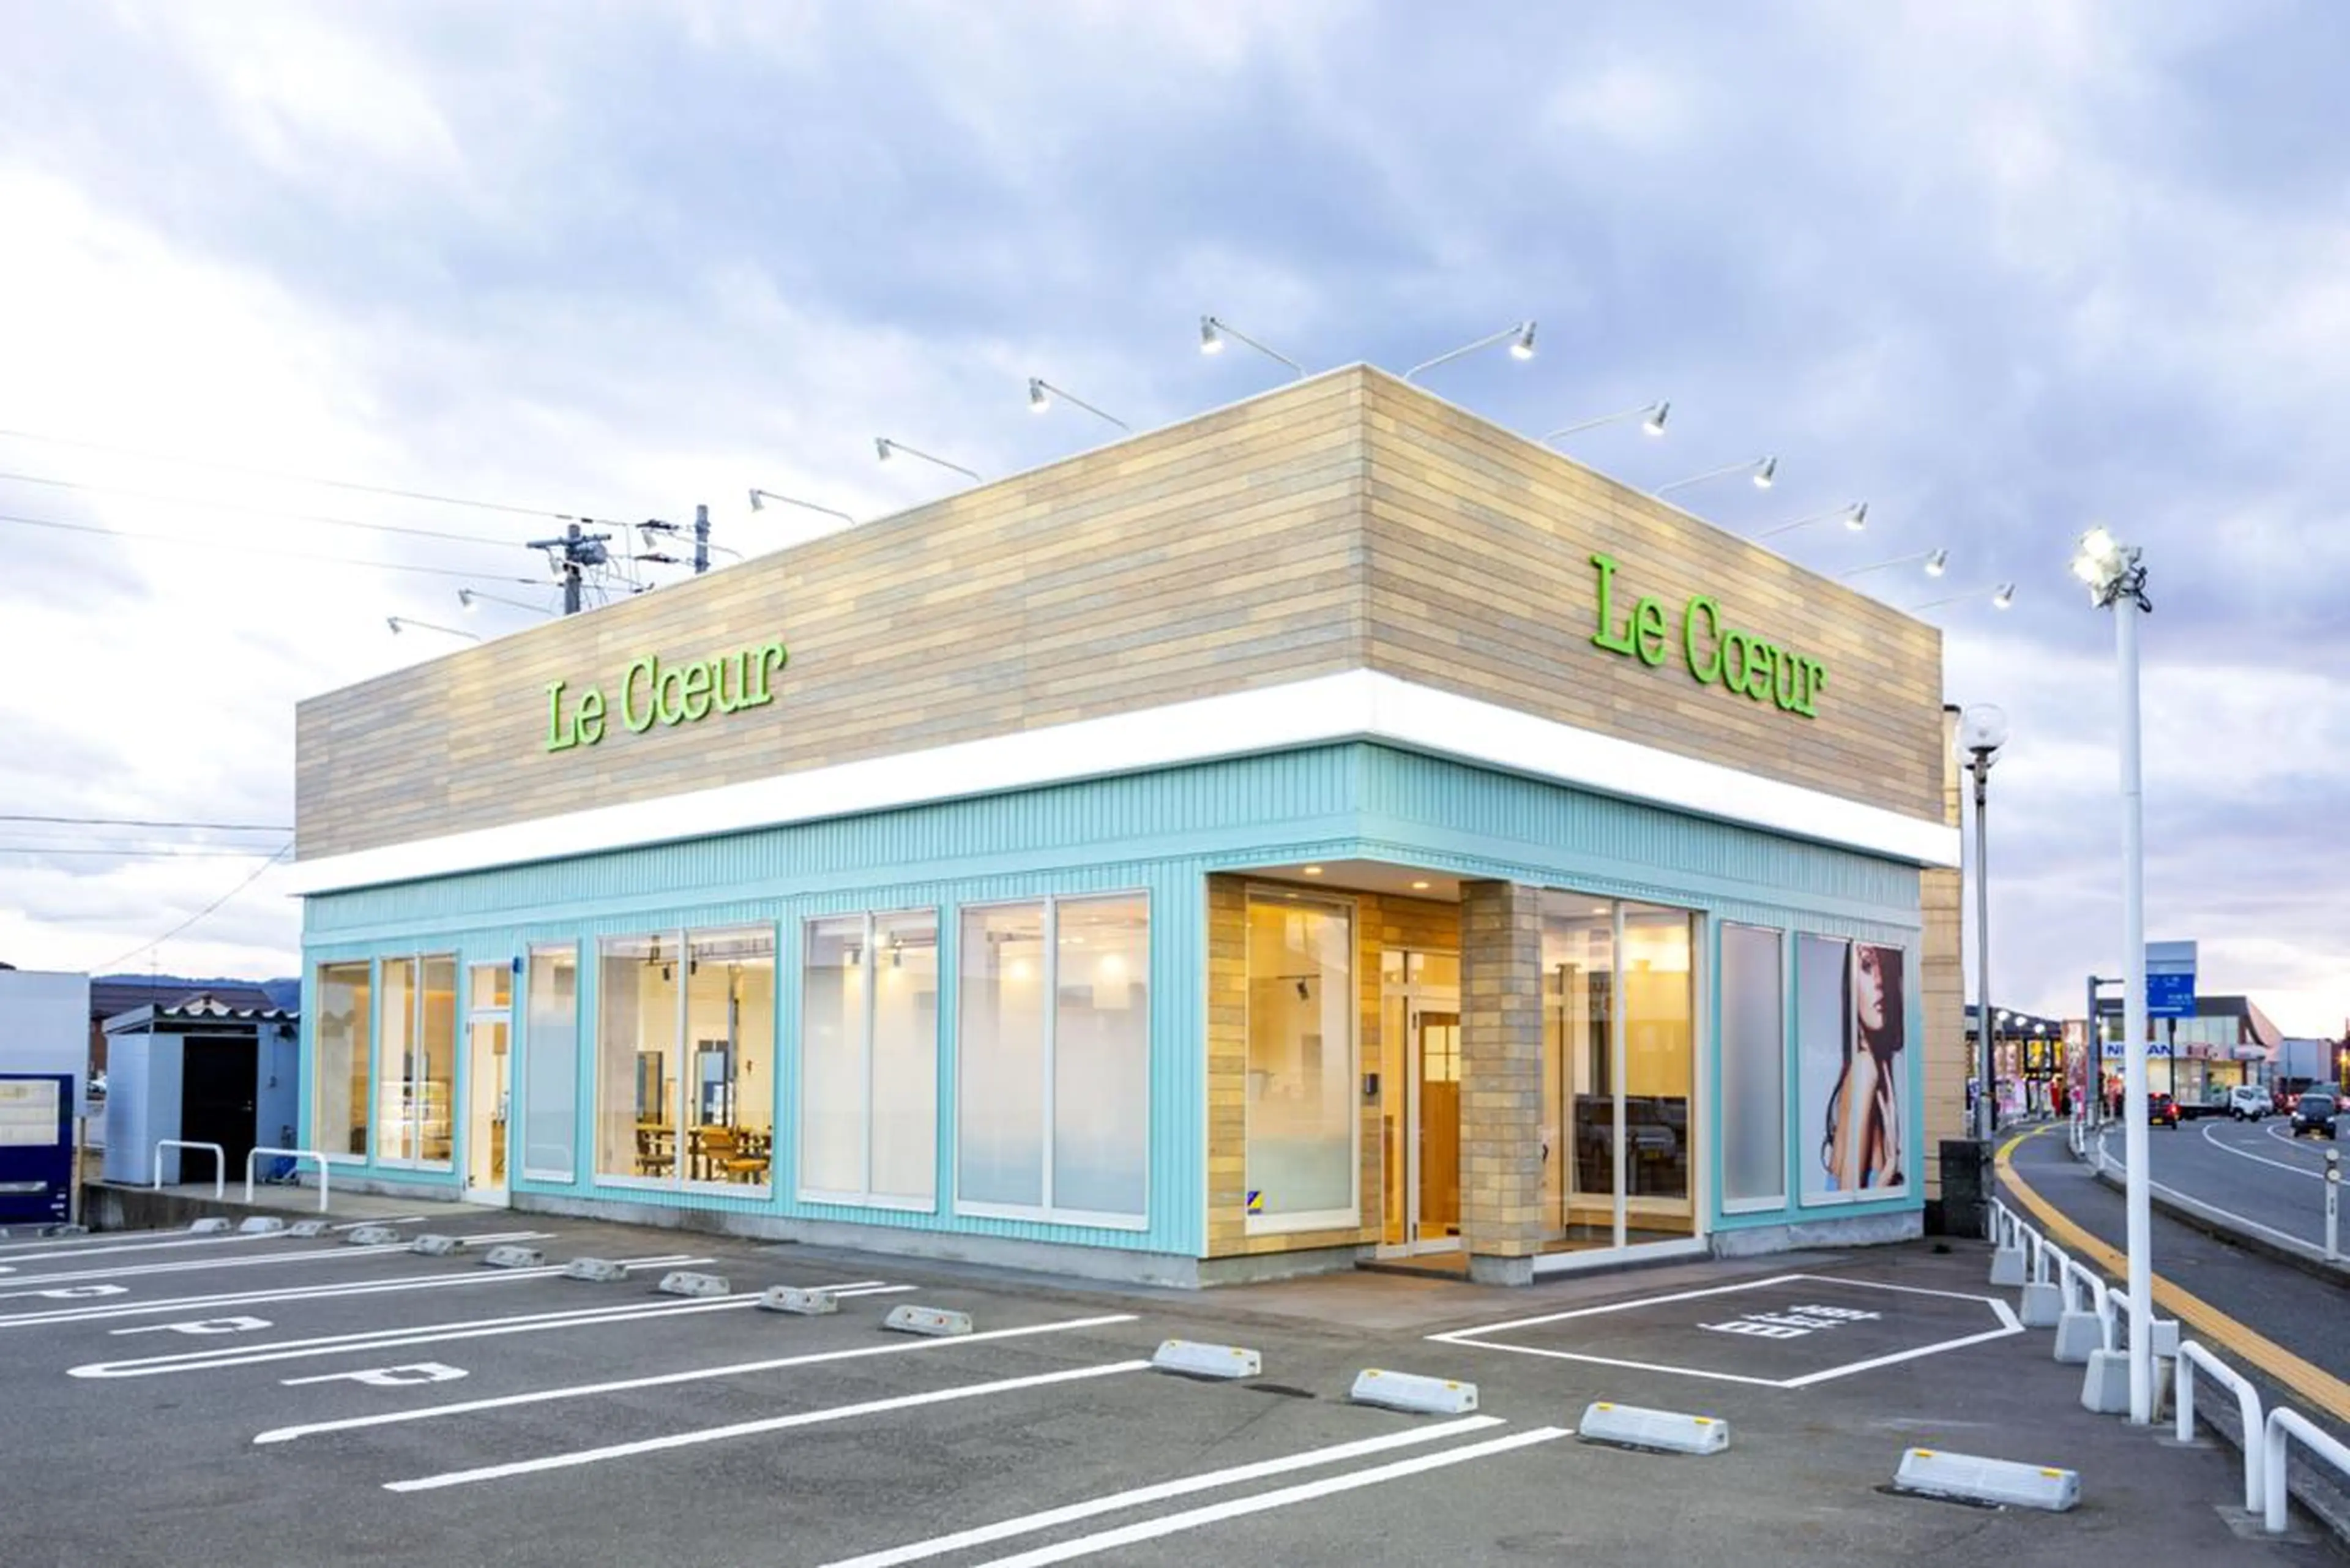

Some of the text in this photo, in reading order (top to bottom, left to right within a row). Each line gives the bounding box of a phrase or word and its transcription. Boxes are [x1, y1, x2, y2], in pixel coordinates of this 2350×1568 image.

[1590, 553, 1829, 718] Le Cœur
[546, 642, 787, 752] Le Cœur
[2107, 1044, 2173, 1056] NIAN
